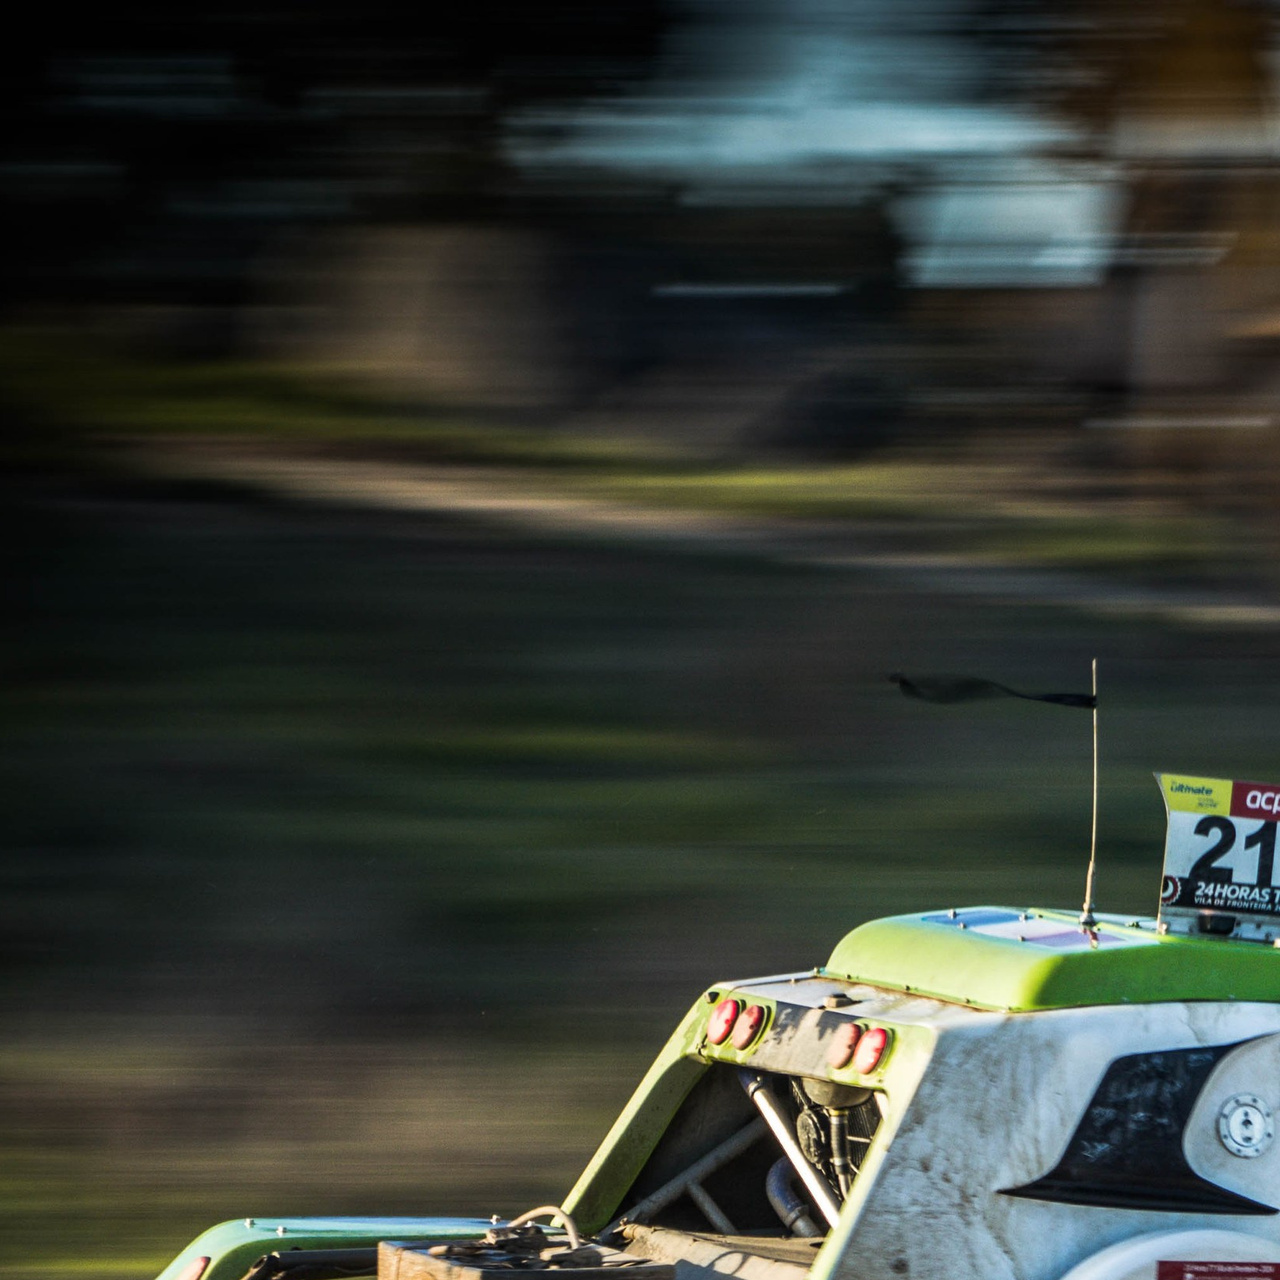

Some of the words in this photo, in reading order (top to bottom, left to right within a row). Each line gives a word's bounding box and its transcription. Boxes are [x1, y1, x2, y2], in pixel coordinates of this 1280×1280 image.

[1189, 815, 1277, 887] 21
[1194, 896, 1212, 905] VILA
[1213, 898, 1224, 907] DE
[1226, 900, 1272, 911] FRONTEIRA
